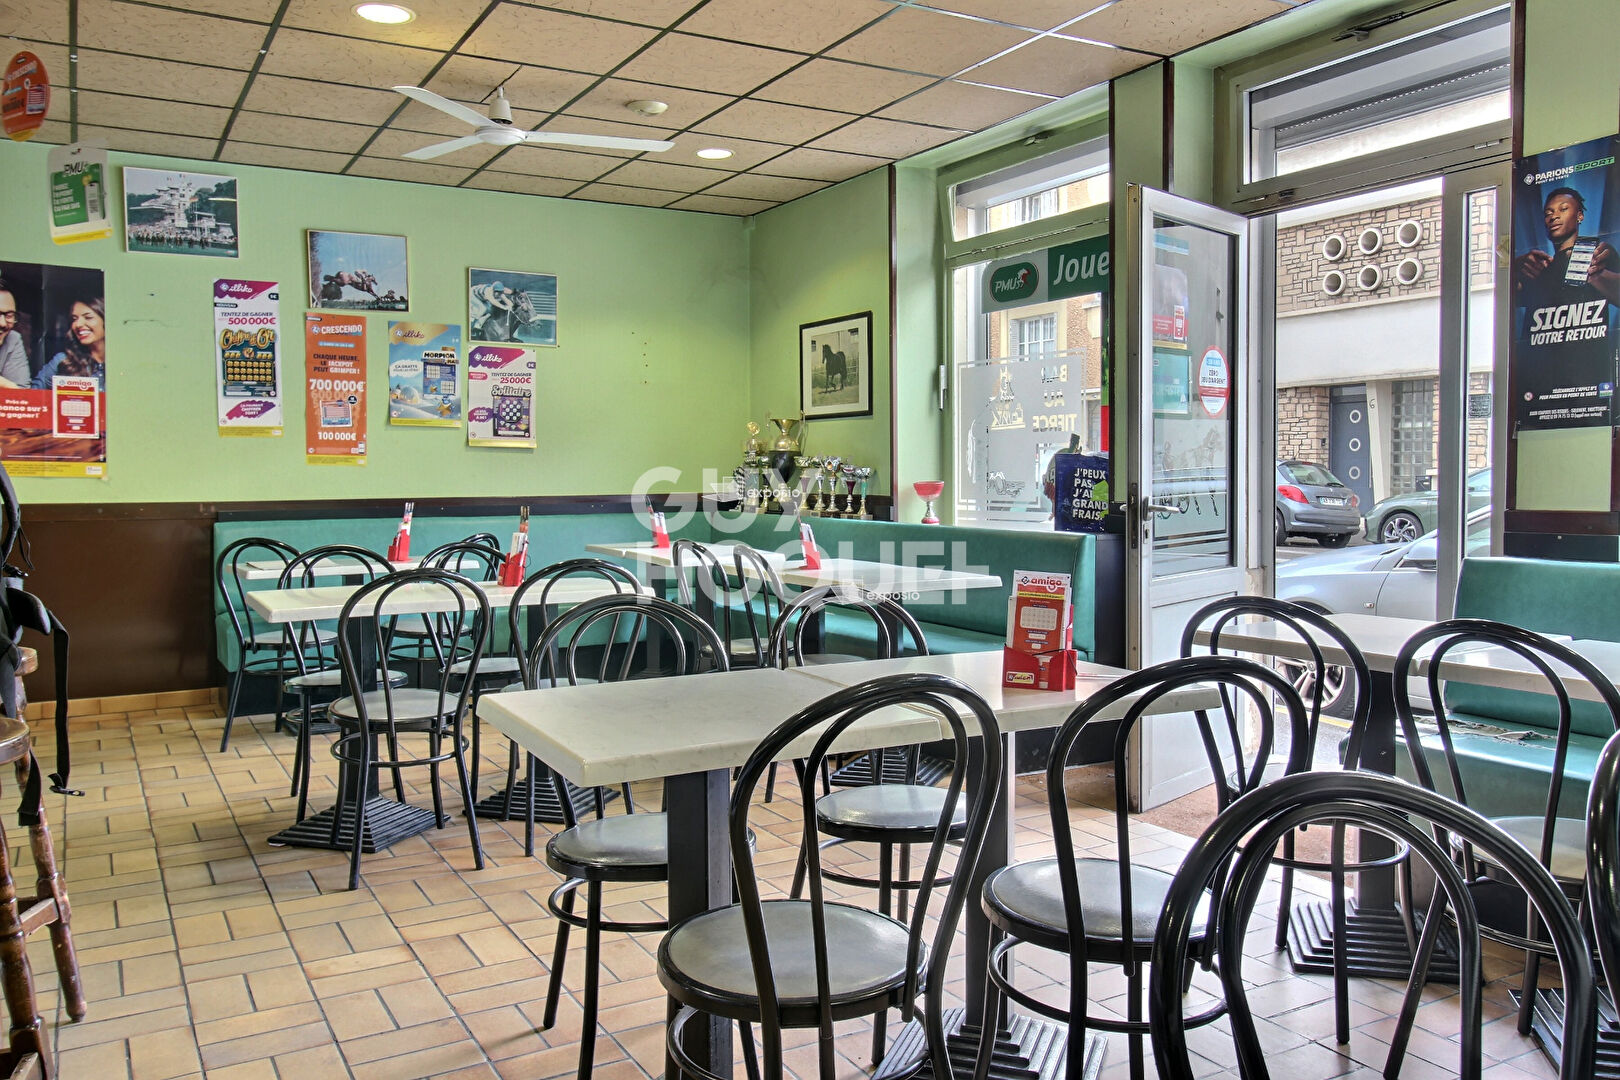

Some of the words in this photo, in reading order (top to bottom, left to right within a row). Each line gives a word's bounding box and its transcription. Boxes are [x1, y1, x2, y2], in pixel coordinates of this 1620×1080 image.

[1535, 166, 1574, 181] PARIONS
[1576, 158, 1613, 171] SPORT
[228, 317, 247, 325] 500
[248, 317, 276, 325] 000€
[1530, 299, 1607, 332] SIGNEZ
[321, 325, 363, 335] CRESCENDO
[1531, 331, 1565, 346] VOTRE
[1566, 325, 1608, 341] RETOUR
[67, 380, 92, 389] amigo
[309, 378, 332, 391] 700
[491, 385, 532, 397] Solitaire
[1369, 398, 1375, 409] 6
[318, 432, 334, 440] 100
[1074, 468, 1106, 479] J'PEUX
[1072, 498, 1109, 510] GRAND
[1031, 577, 1062, 590] amigo
